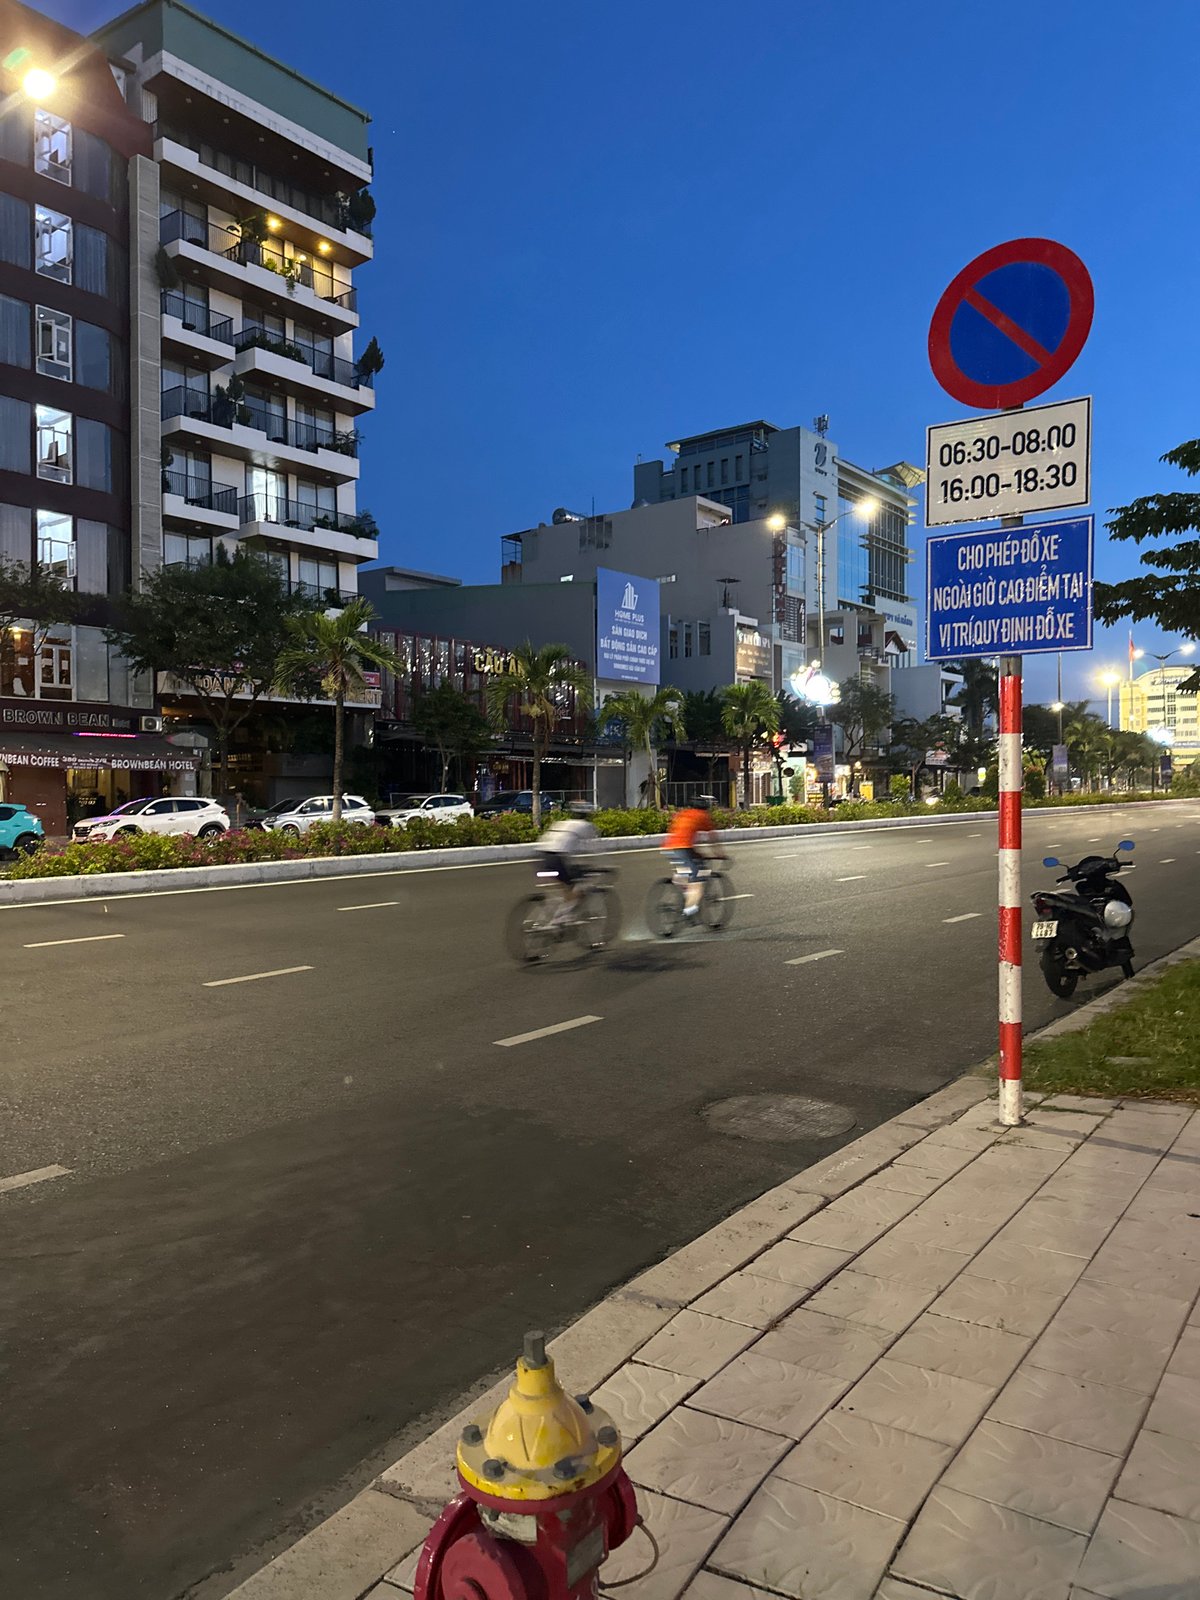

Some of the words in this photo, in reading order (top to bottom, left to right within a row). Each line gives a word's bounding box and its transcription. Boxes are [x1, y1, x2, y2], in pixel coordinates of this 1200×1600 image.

[940, 423, 1076, 467] 06:30-08:00
[940, 461, 1077, 503] 16:00-18:30
[958, 546, 983, 571] CHO
[985, 534, 1020, 568] PHÉP
[1021, 530, 1039, 563] ĐỖ
[1041, 534, 1059, 561] XE
[933, 578, 971, 611] NGOÀI
[973, 575, 997, 607] GIỜ
[998, 578, 1024, 606] CAO
[1025, 564, 1060, 603] ĐIỂM
[1062, 571, 1084, 602] TẠI
[615, 610, 631, 620] HOME
[632, 613, 644, 622] PLUS
[611, 625, 623, 636] SÀN
[623, 627, 635, 639] GIAO
[636, 630, 648, 641] DỊCH
[939, 623, 951, 651] VỊ
[952, 615, 975, 647] TRÍ
[974, 619, 1001, 646] QUY
[1001, 616, 1033, 646] ĐỊNH
[1035, 606, 1055, 640] ĐỖ
[1056, 612, 1075, 639] XE
[600, 635, 611, 648] BẤT
[637, 644, 647, 655] CAO
[648, 643, 658, 656] CẤP
[475, 646, 504, 674] CẦU
[3, 708, 63, 725] BROWN
[67, 712, 110, 727] BEAN
[30, 755, 60, 767] COFFEE
[111, 759, 167, 769] BROWNBEAN
[168, 760, 195, 770] HOTEL
